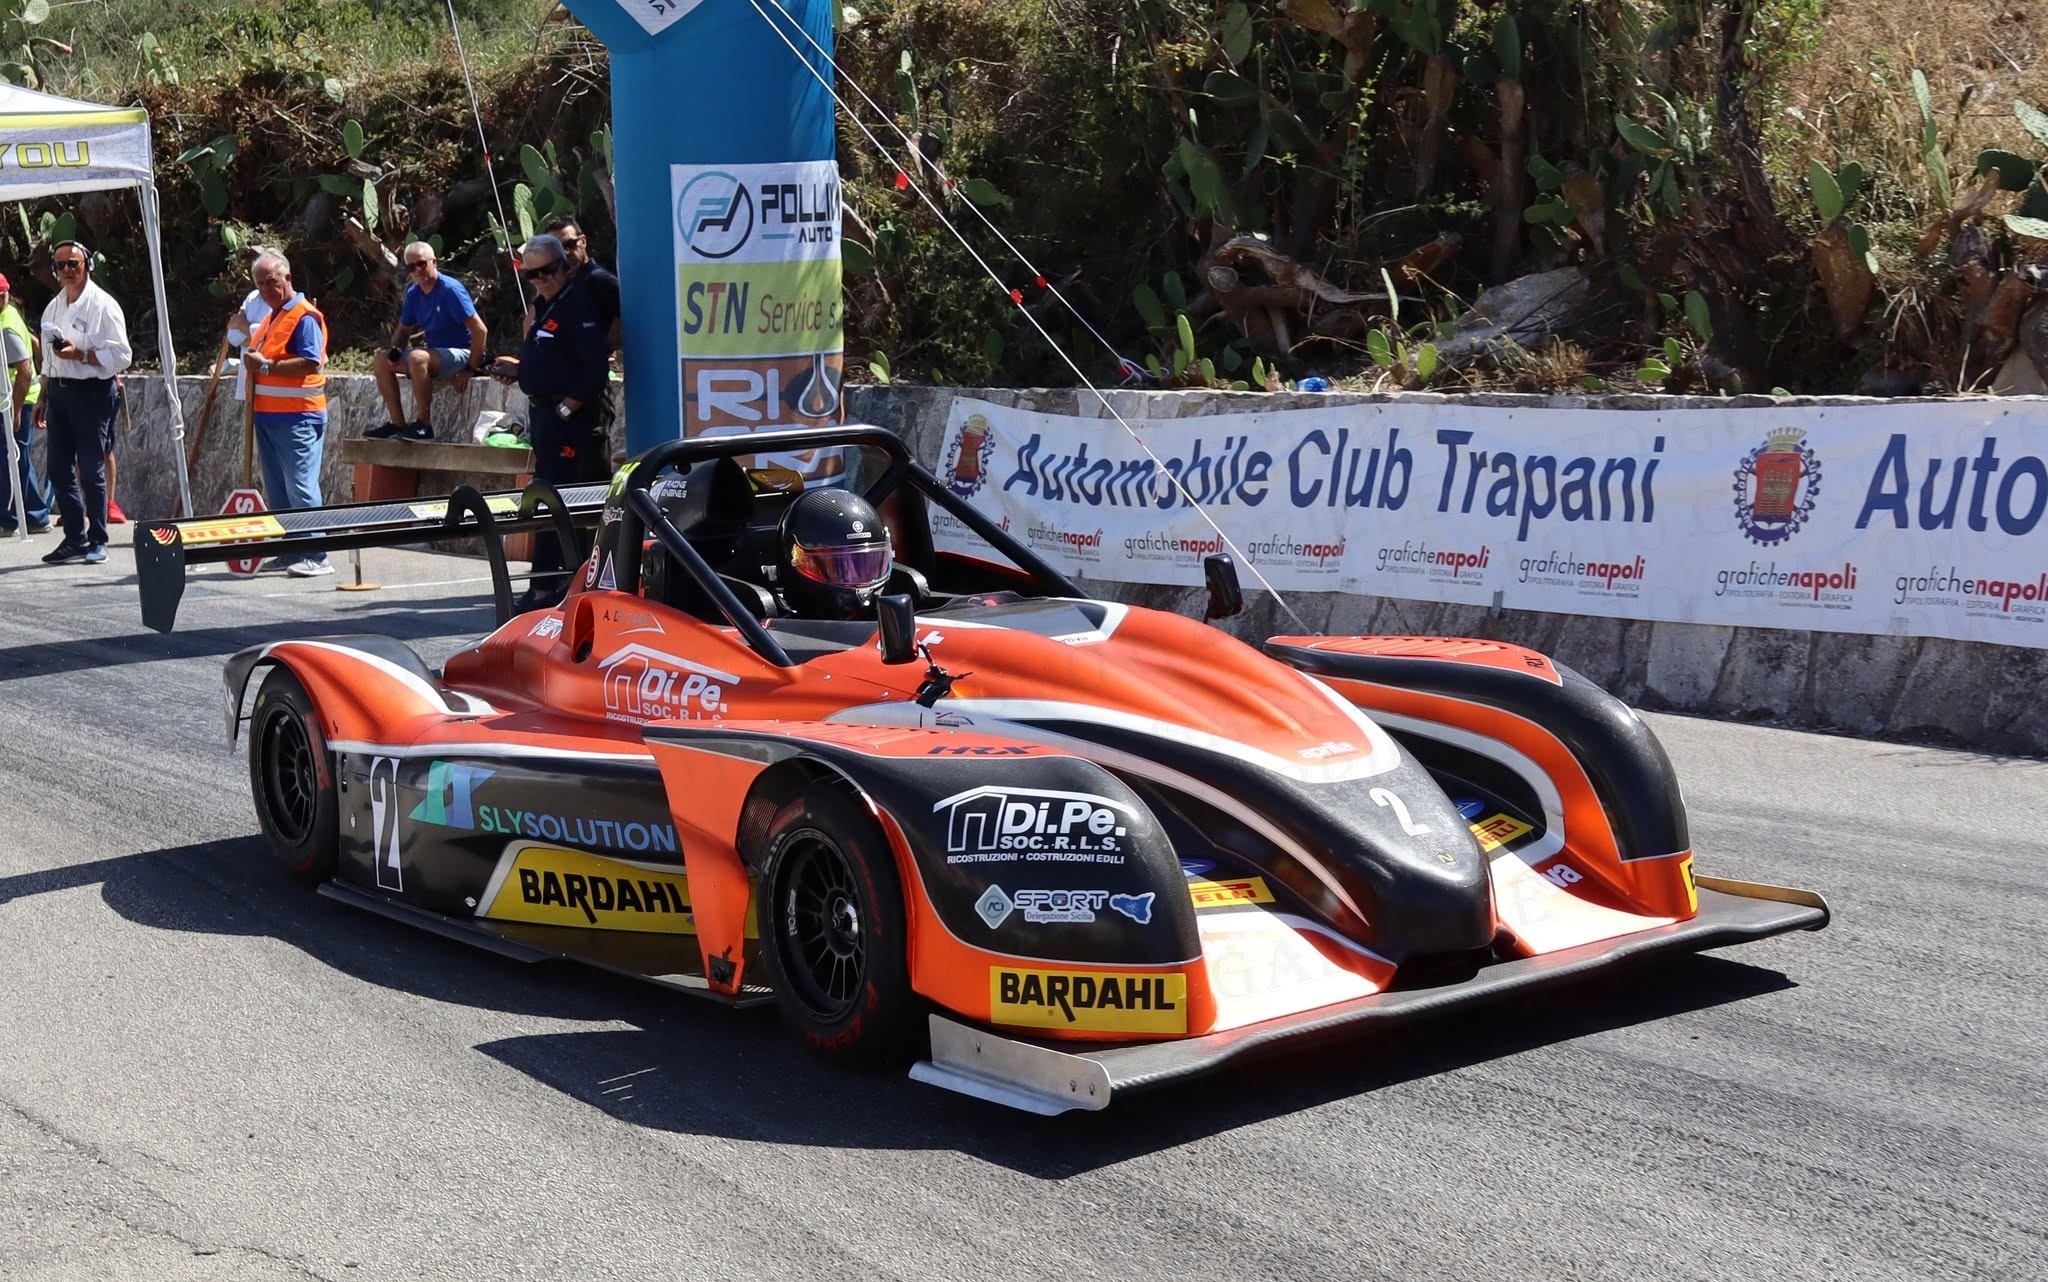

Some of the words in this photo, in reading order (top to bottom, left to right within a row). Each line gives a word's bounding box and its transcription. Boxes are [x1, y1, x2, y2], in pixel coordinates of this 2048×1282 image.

[798, 226, 833, 244] AUTO
[683, 281, 750, 335] STN
[757, 294, 823, 334] Service
[697, 368, 780, 421] RI
[1003, 433, 1273, 510] Automobile
[1288, 427, 1413, 511] Club
[1436, 429, 1666, 542] Trapani
[1027, 521, 1104, 555] grafichenapoli
[1123, 529, 1224, 563] grafichenapoli
[1248, 534, 1347, 568] grafichenapoli
[1376, 539, 1490, 578] grafichenapoli
[1518, 550, 1646, 590] grafichenapoli
[1714, 560, 1858, 601] grafichenapoli
[641, 667, 728, 713] Di.Pe.
[370, 757, 402, 891] 2
[1001, 801, 1127, 837] Di.Pe.
[1368, 787, 1433, 836] 2
[947, 853, 1018, 864] RICOSTRUZIONI
[1026, 852, 1095, 863] COSTRUZIONI
[1095, 854, 1125, 864] EDILI
[518, 868, 693, 925] BARDAHL
[1014, 891, 1108, 911] SPORT
[1026, 911, 1070, 921] Delegazione
[1070, 911, 1093, 920] Sicilia
[1000, 972, 1176, 1023] BARDAHL
